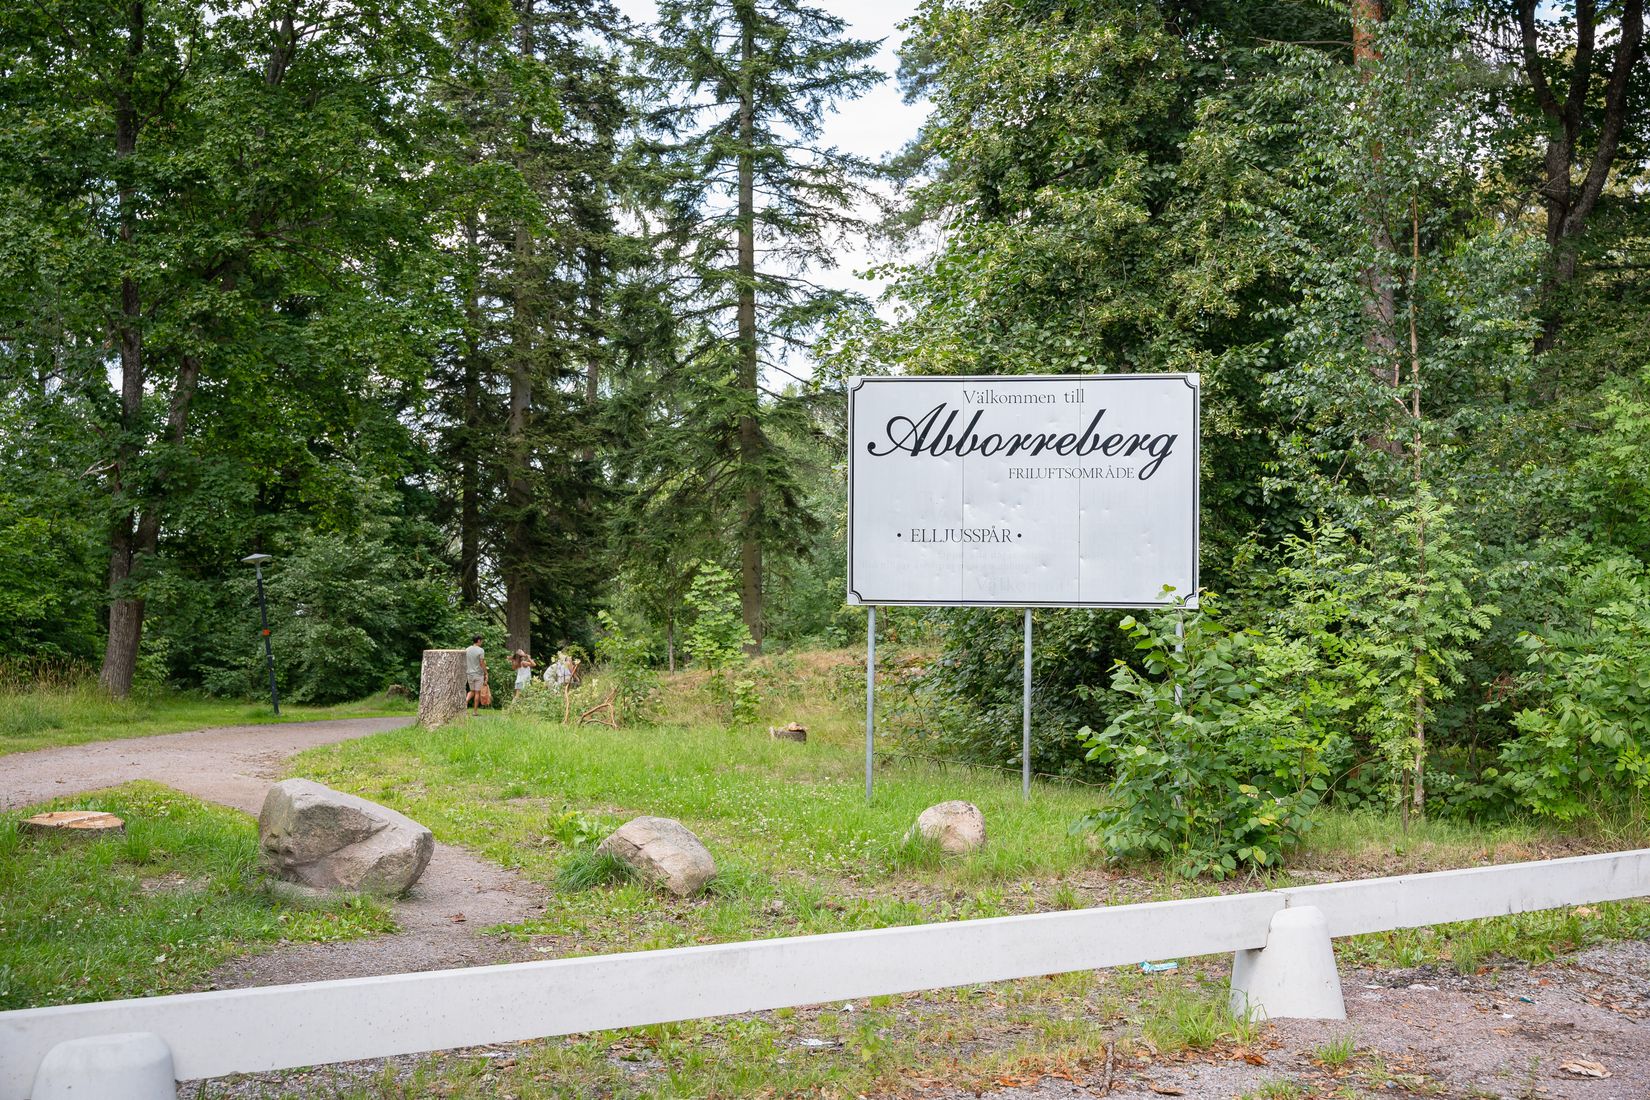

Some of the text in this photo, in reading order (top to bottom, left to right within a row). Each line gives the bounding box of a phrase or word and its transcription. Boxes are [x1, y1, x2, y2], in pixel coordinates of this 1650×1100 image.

[963, 388, 1084, 403] Välkommen till
[867, 402, 1178, 481] Abborreberg
[1008, 466, 1135, 480] FRILUFTSOMRÅDE
[910, 525, 1013, 543] ELLJUSSPÅR
